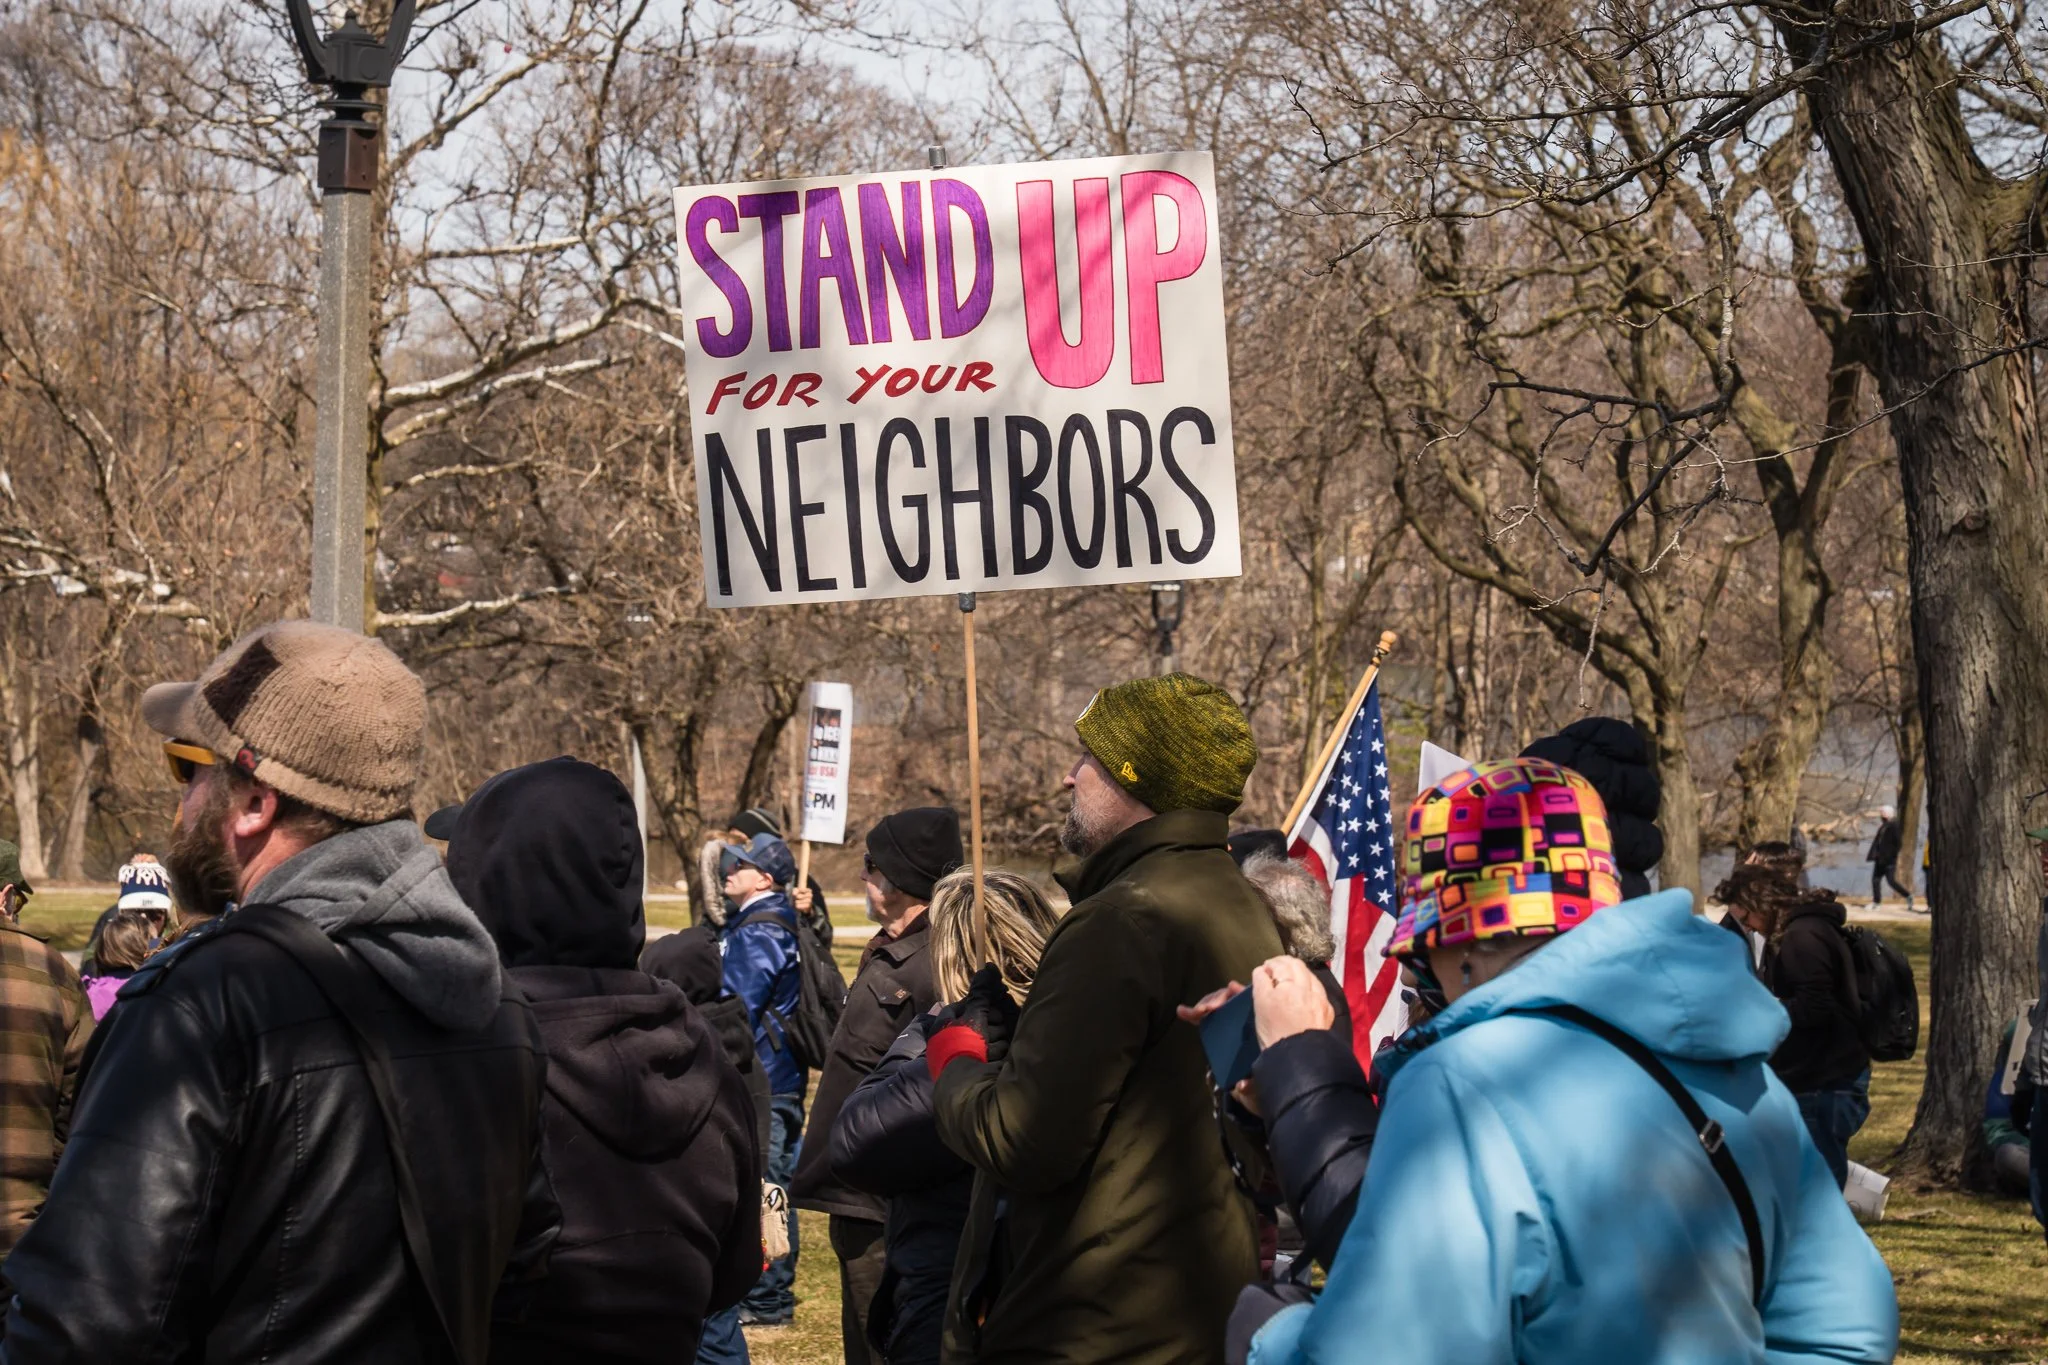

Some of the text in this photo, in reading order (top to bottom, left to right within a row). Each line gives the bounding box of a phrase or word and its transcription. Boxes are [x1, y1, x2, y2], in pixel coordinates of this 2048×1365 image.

[685, 170, 1207, 389] STAND UP
[706, 361, 997, 415] FOR YOUR
[705, 406, 1216, 596] NEIGHBORS
